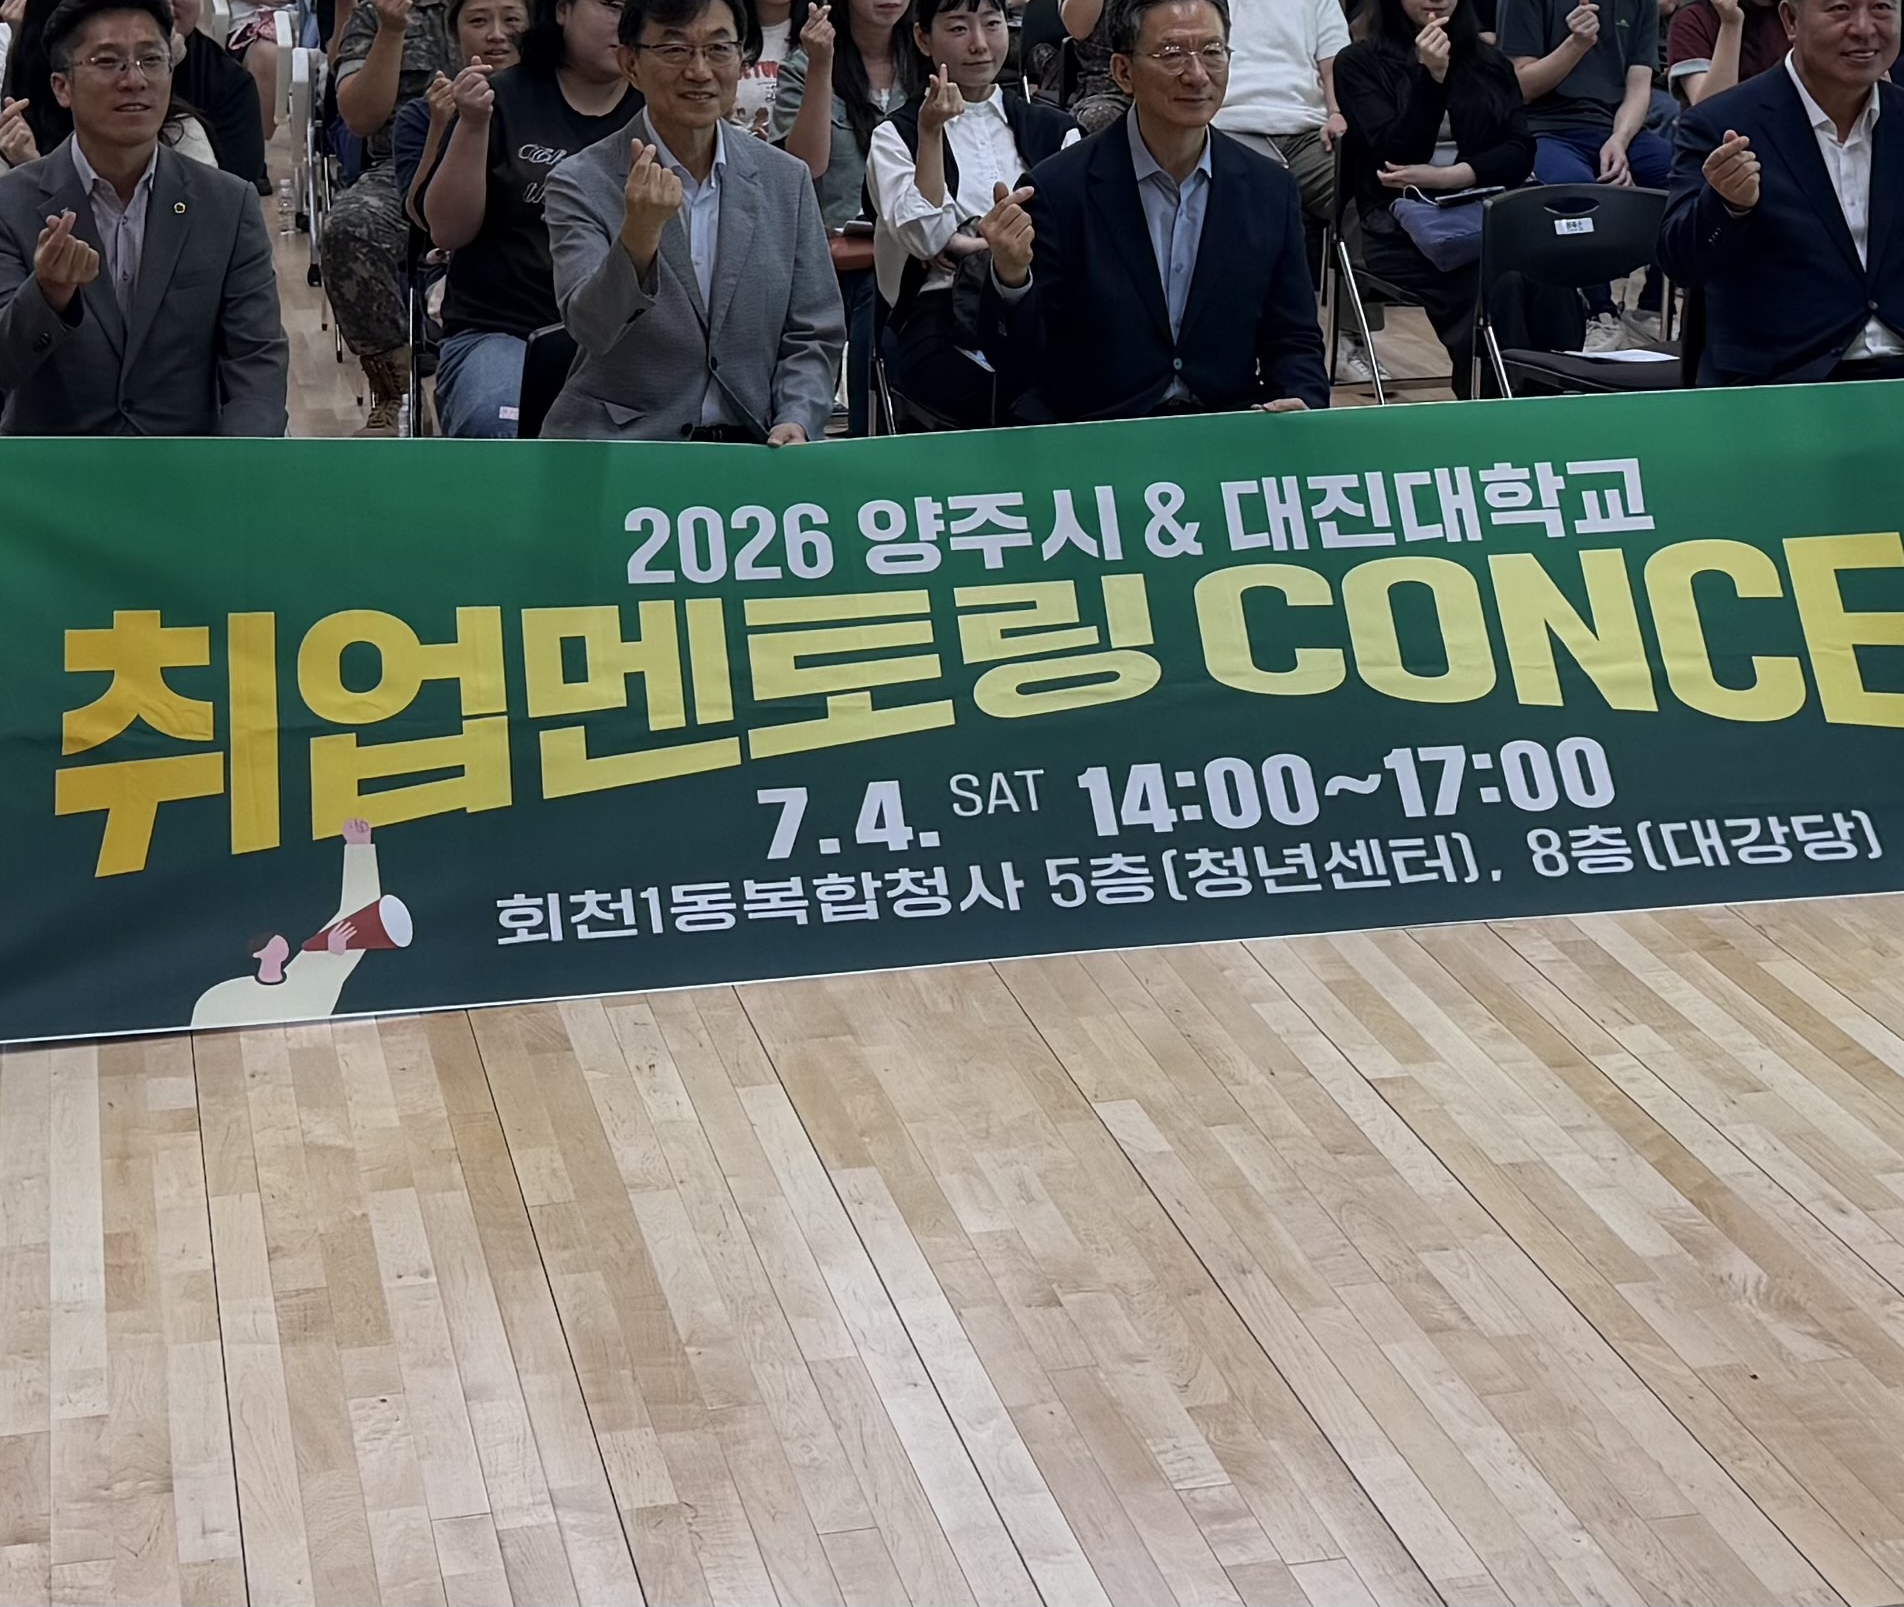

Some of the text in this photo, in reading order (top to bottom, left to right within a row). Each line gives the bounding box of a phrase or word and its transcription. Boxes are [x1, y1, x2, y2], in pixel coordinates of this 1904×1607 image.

[624, 458, 1655, 584] 2026 양주시 & 대진대학교
[55, 573, 1163, 878] 취업멘토링
[949, 769, 1045, 817] SAT
[1077, 736, 1616, 837] 14:00~17:00
[496, 861, 1025, 945] 회천1동복합청사
[1526, 809, 1883, 877] 8층(대강당)
